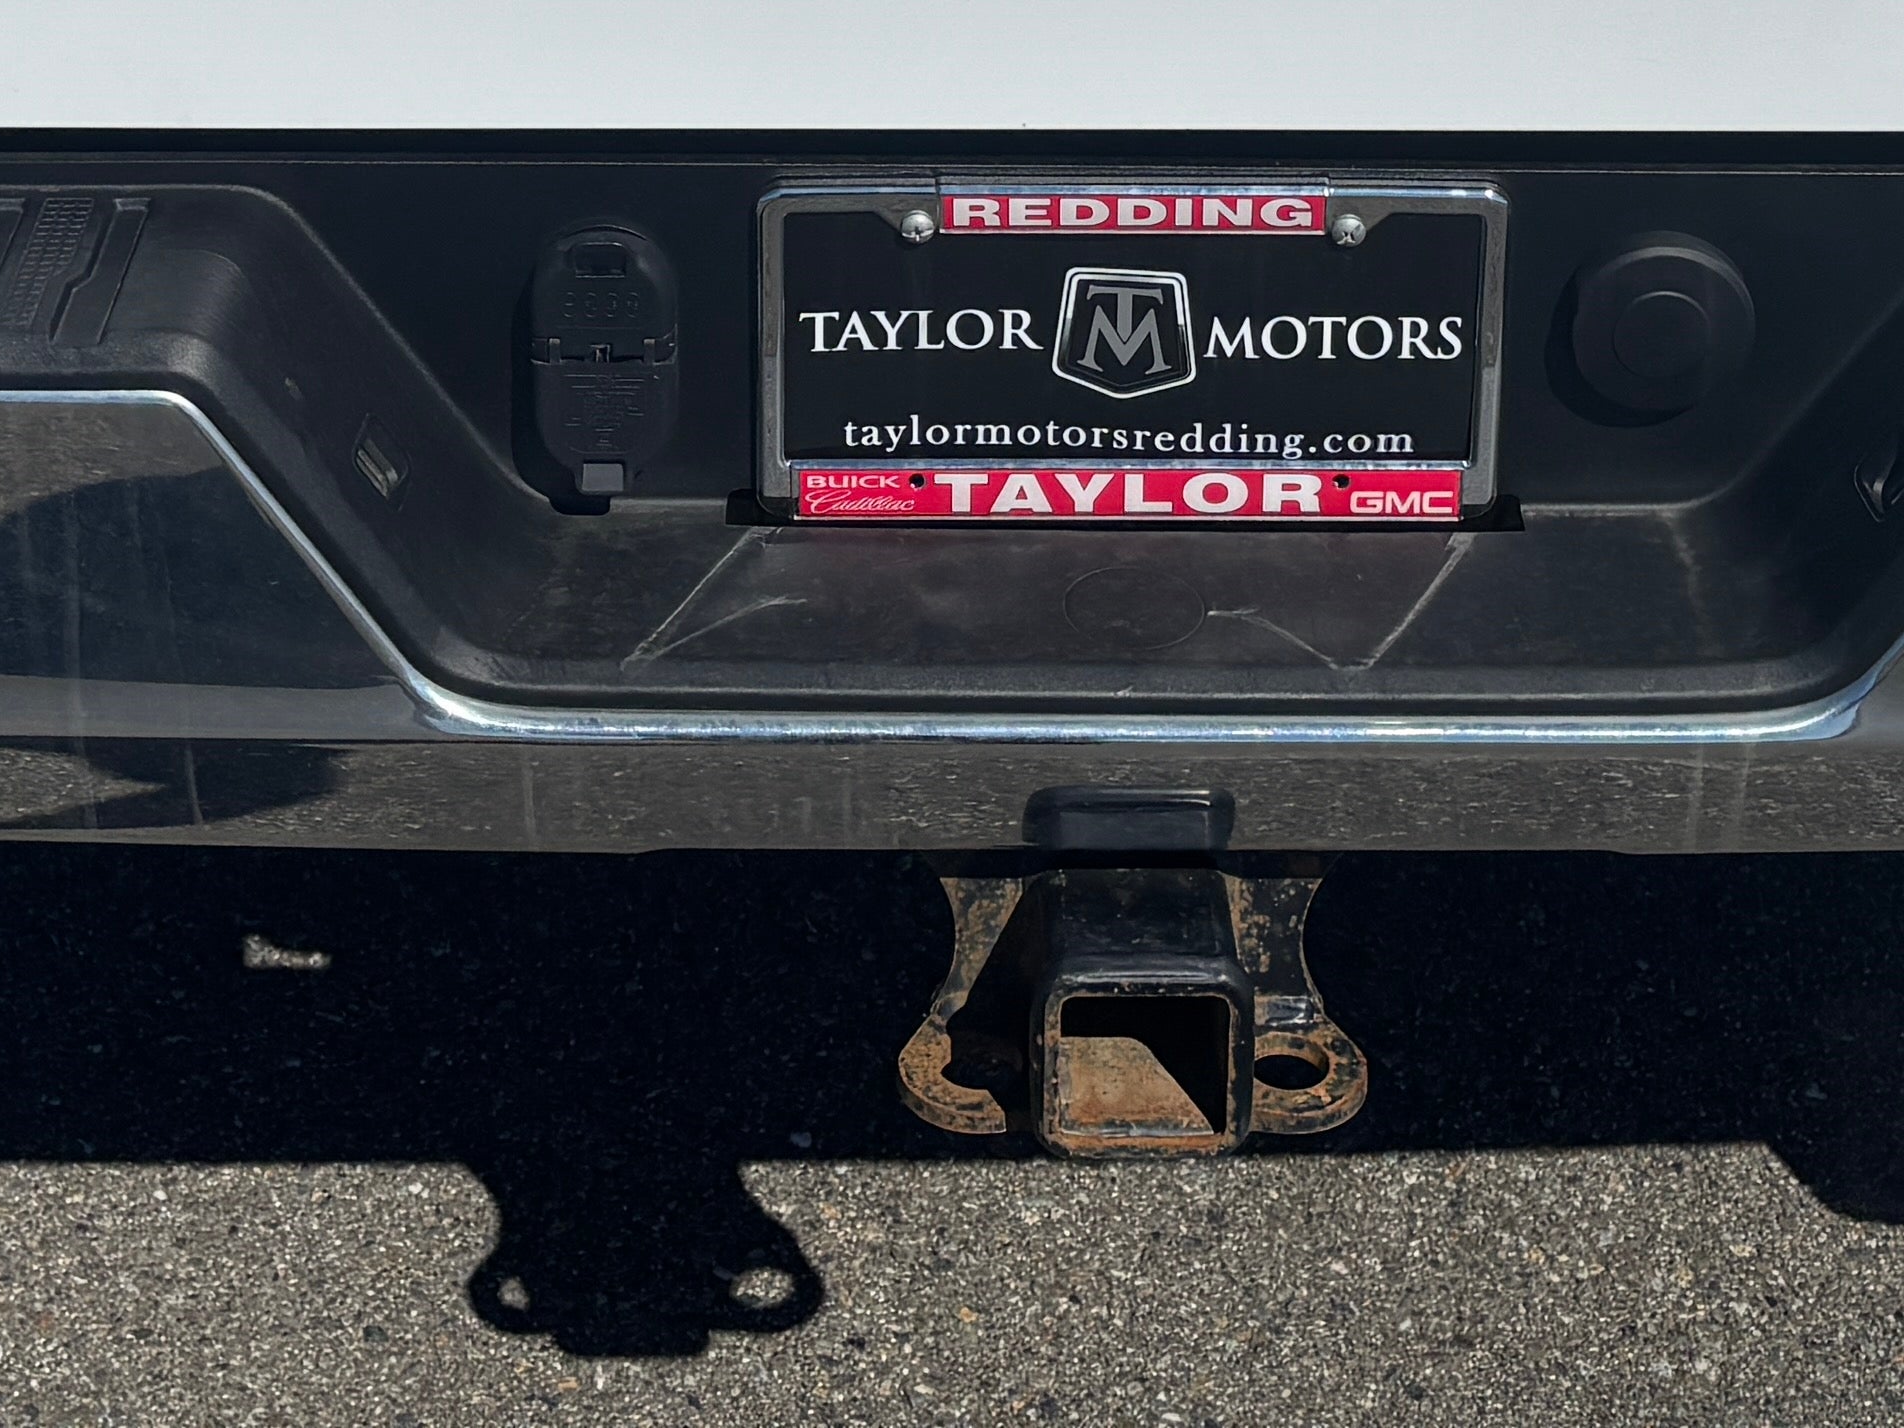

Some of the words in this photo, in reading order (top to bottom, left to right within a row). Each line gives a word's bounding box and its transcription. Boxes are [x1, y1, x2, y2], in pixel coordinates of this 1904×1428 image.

[952, 197, 1312, 227] REDDING
[798, 307, 1044, 354] TAYLOR
[1203, 314, 1464, 361] MOTORS
[843, 415, 1414, 459] taylormotorsredding.com
[804, 489, 915, 514] Cadillac
[806, 475, 901, 489] BUICK
[933, 472, 1323, 515] TAYLOR
[1349, 490, 1455, 515] GMC
